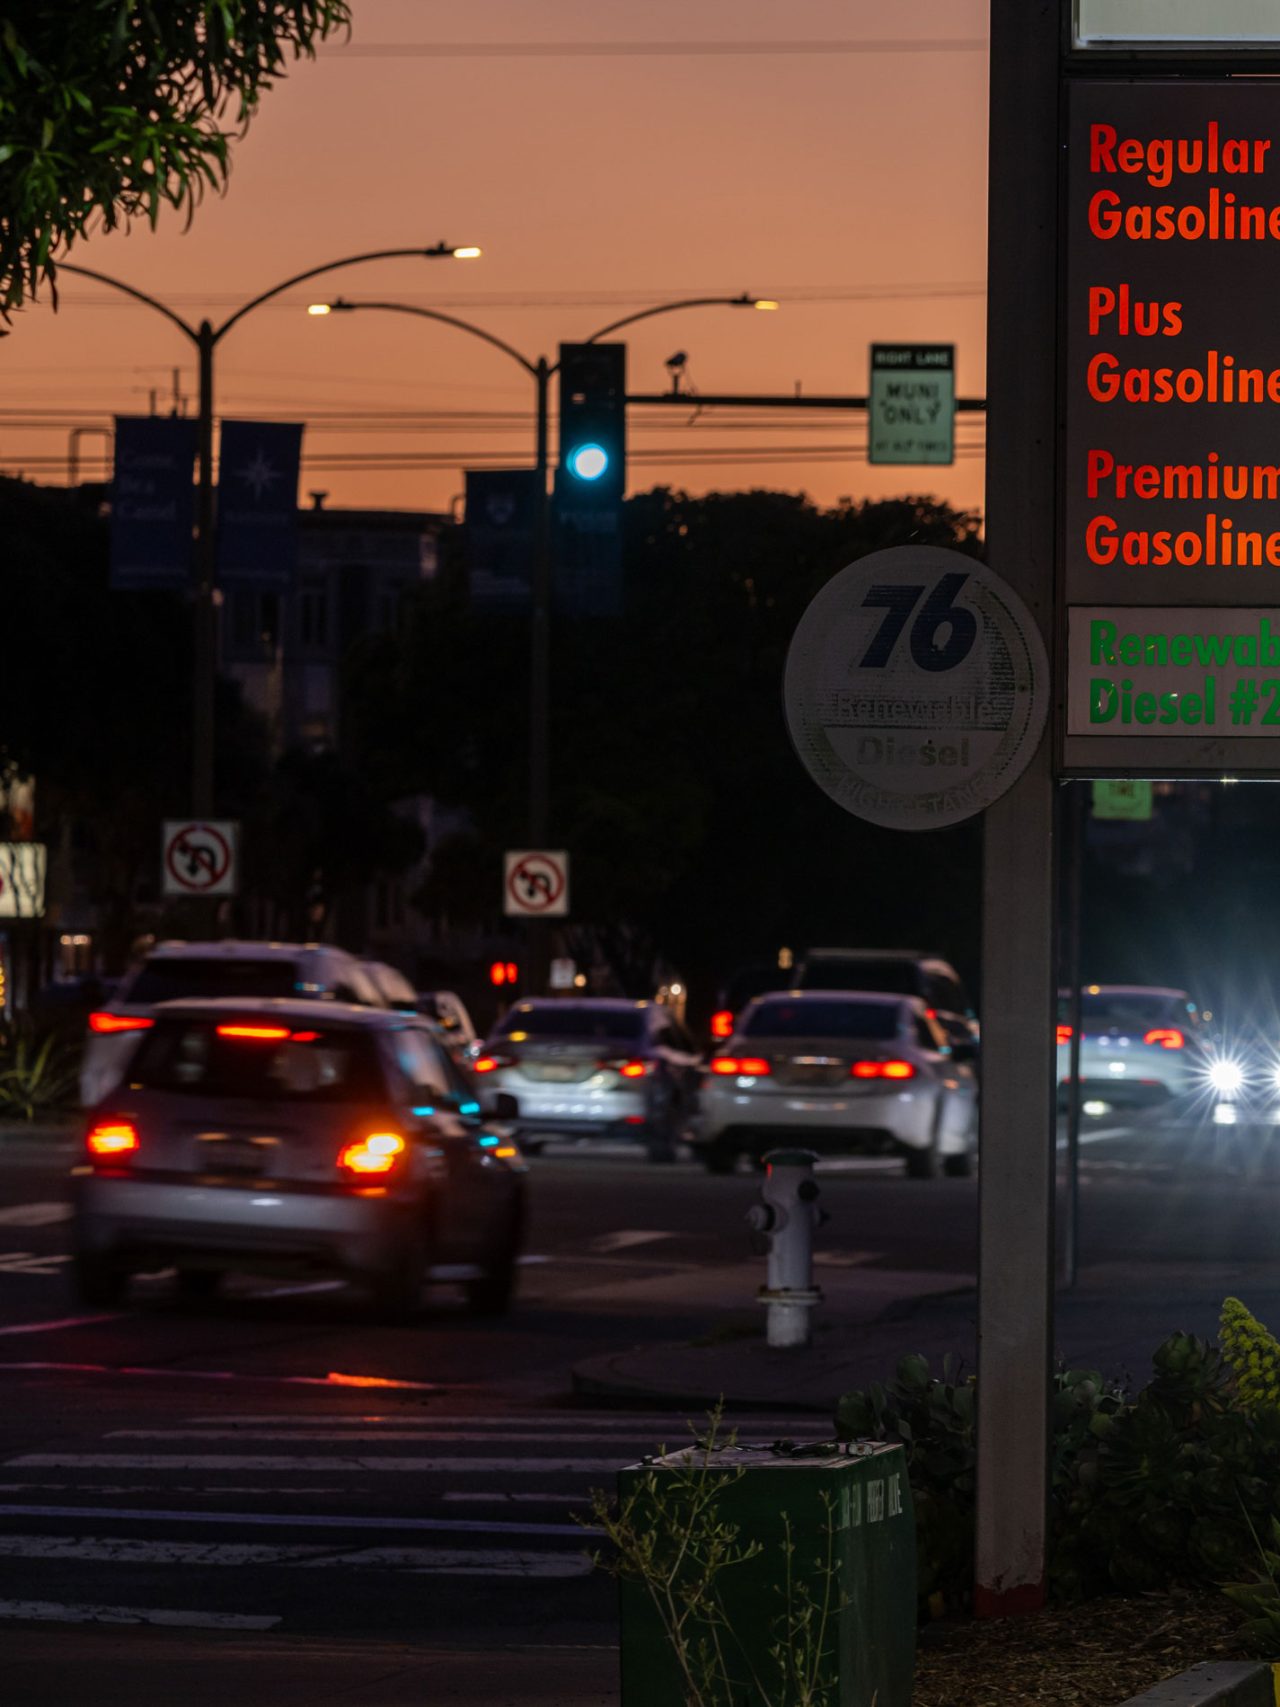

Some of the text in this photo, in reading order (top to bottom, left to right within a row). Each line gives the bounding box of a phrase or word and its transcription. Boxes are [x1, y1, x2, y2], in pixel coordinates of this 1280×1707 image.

[1091, 121, 1271, 188] Regular
[1088, 283, 1183, 337] Plus
[884, 404, 941, 425] ONLY
[858, 573, 977, 673] 76
[1090, 678, 1215, 725] Diesel
[857, 736, 970, 767] Diesel
